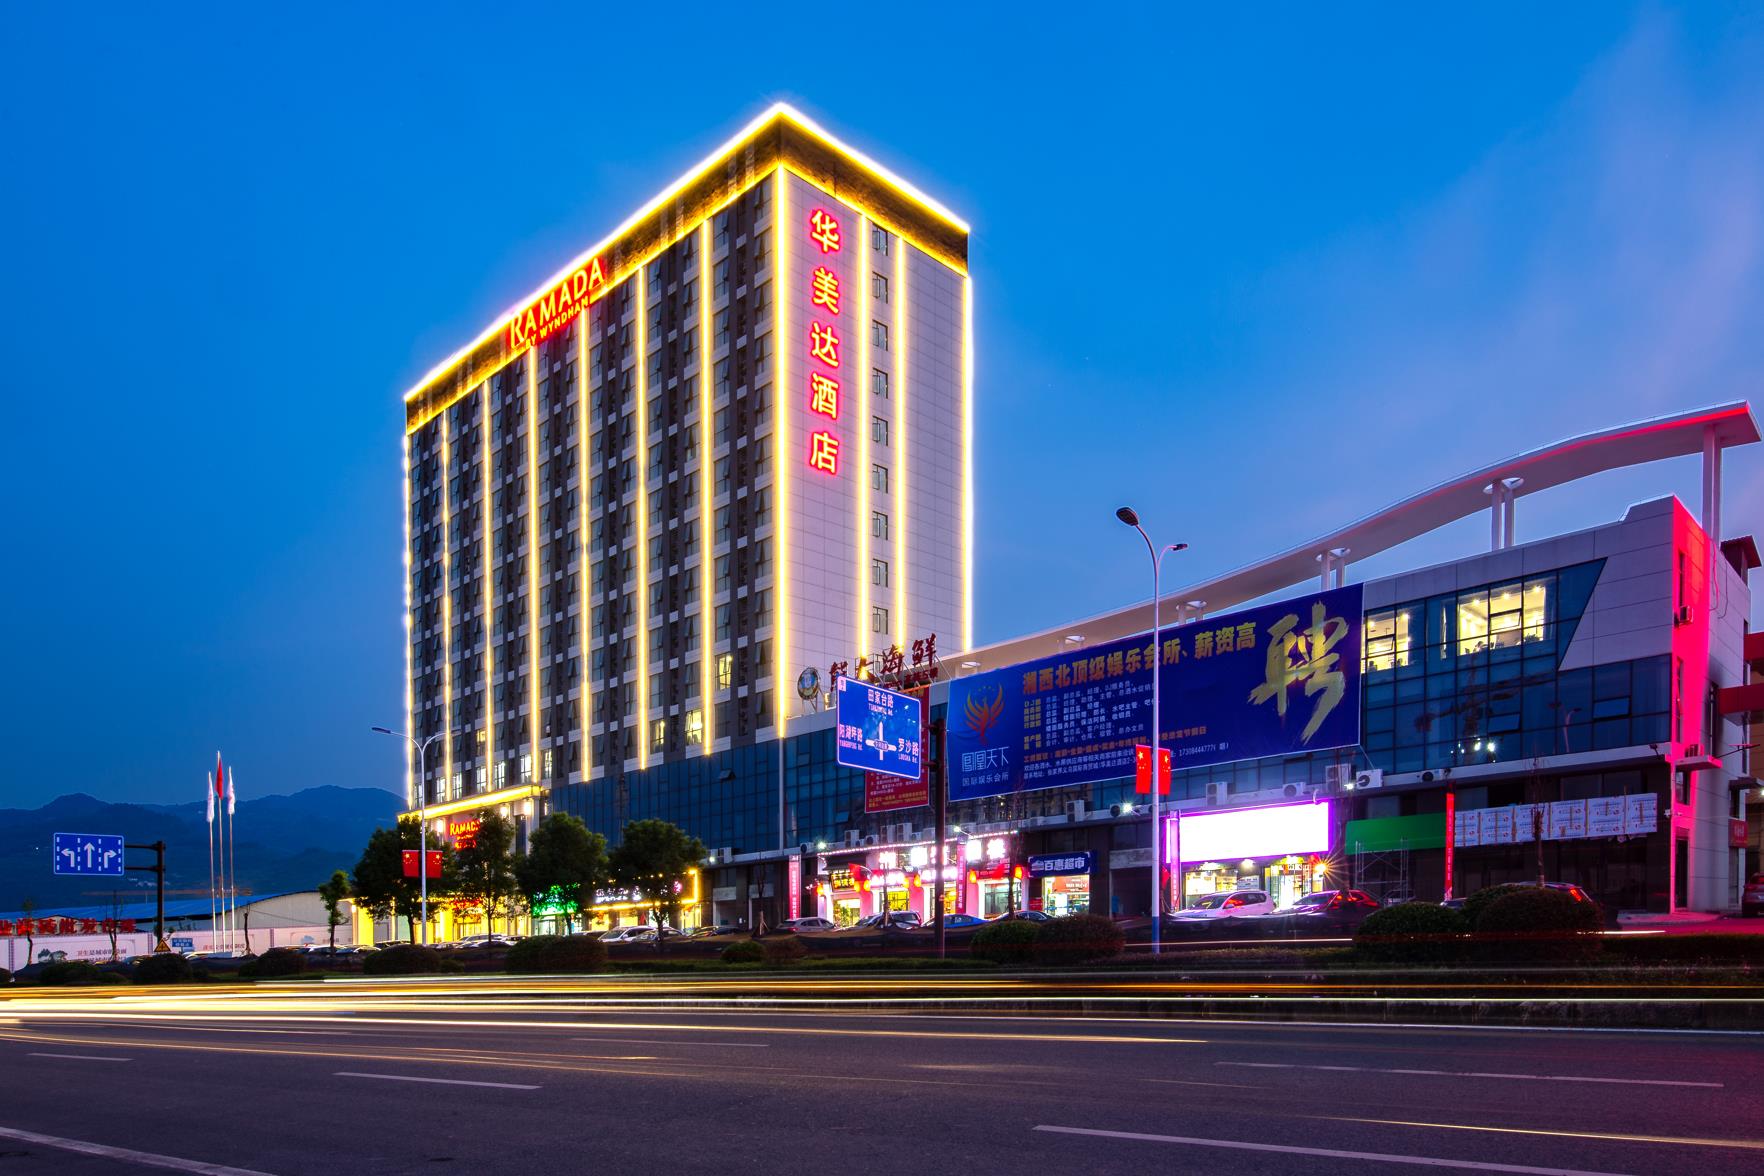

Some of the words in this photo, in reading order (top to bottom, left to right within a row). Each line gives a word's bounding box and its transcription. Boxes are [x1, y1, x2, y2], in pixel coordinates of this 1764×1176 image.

[510, 256, 604, 350] RAMADA
[525, 334, 536, 350] BY
[540, 295, 589, 338] WYNDHAM
[810, 210, 840, 474] 华美达酒店
[1247, 601, 1350, 746] 聘
[962, 772, 1009, 787] 国际娱乐会所
[1044, 857, 1085, 871] 百惠超市
